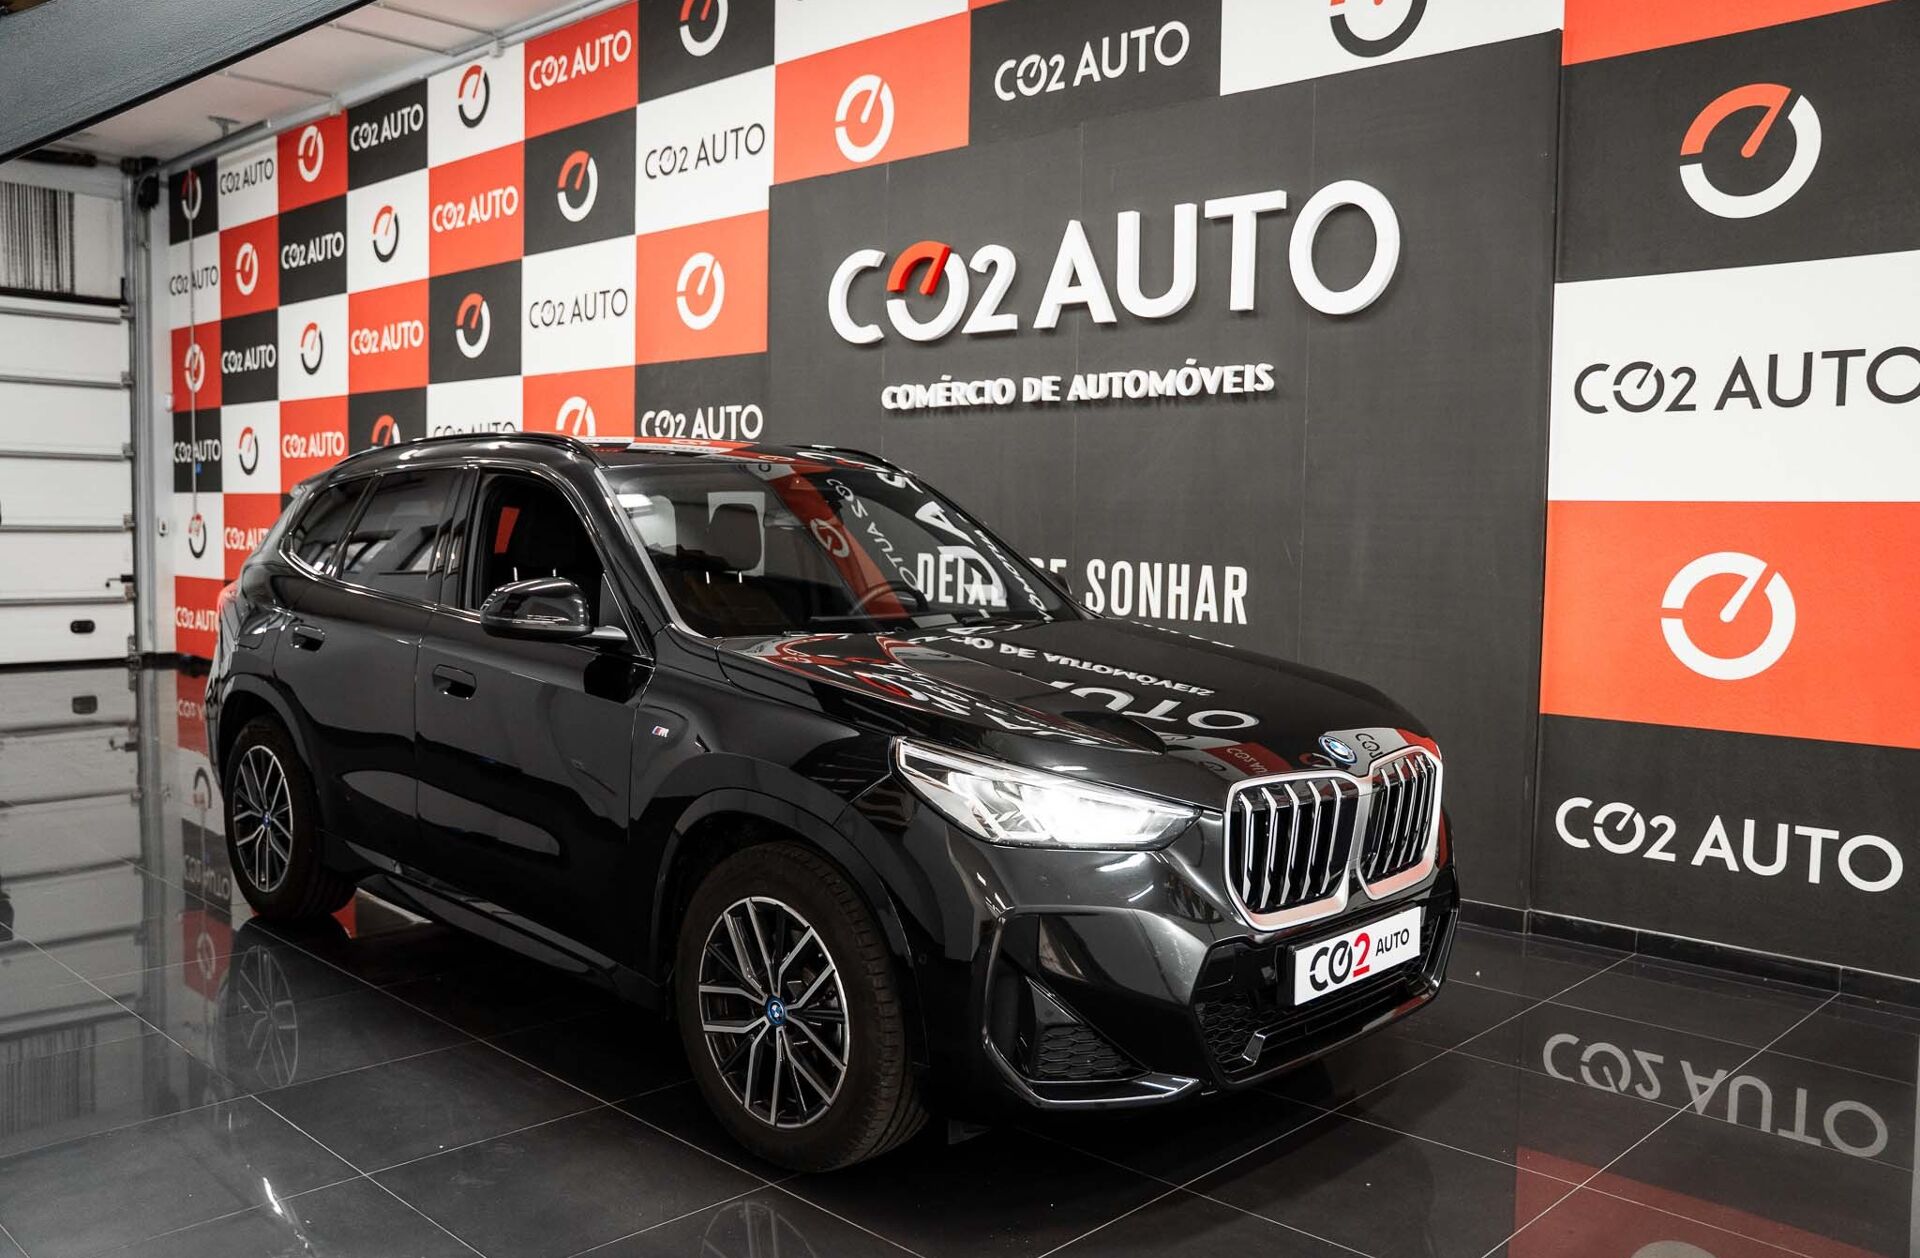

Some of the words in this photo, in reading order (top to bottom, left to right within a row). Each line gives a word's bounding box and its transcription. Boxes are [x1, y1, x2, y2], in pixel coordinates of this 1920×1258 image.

[529, 55, 567, 90] CO2
[571, 29, 631, 78] AUTO
[995, 53, 1065, 102] CO2
[1073, 20, 1189, 86] AUTO
[351, 122, 378, 151] CO2
[380, 103, 424, 142] AUTO
[645, 146, 688, 179] CO2
[695, 123, 765, 170] AUTO
[220, 172, 240, 195] CO2
[243, 158, 274, 188] AUTO
[432, 202, 465, 233] CO2
[467, 185, 518, 225] AUTO
[281, 243, 306, 269] CO2
[307, 231, 344, 264] AUTO
[828, 240, 1017, 344] CO2
[1034, 180, 1400, 329] AUTO
[529, 300, 565, 328] CO2
[570, 288, 628, 324] AUTO
[222, 350, 243, 374] CO2
[244, 344, 277, 371] AUTO
[351, 328, 379, 355] CO2
[381, 320, 424, 352] AUTO
[881, 374, 1016, 410] COMÉRCIO
[1022, 375, 1062, 403] DE
[1067, 358, 1274, 401] AUTOMÓVEIS
[1574, 361, 1697, 414] CO2
[1714, 346, 1920, 410] AUTO
[282, 434, 306, 458] CO2
[307, 431, 344, 457] AUTO
[640, 410, 685, 438] CO2
[691, 404, 763, 440] AUTO
[174, 442, 192, 463] CO2
[194, 439, 221, 462] AUTO
[224, 527, 245, 550] CO2
[1085, 558, 1248, 625] SONHAR
[176, 607, 194, 628] CO2
[1555, 796, 1676, 862] CO2
[1691, 815, 1903, 893] AUTO
[1310, 933, 1370, 991] CO2
[1375, 928, 1409, 956] AUTO
